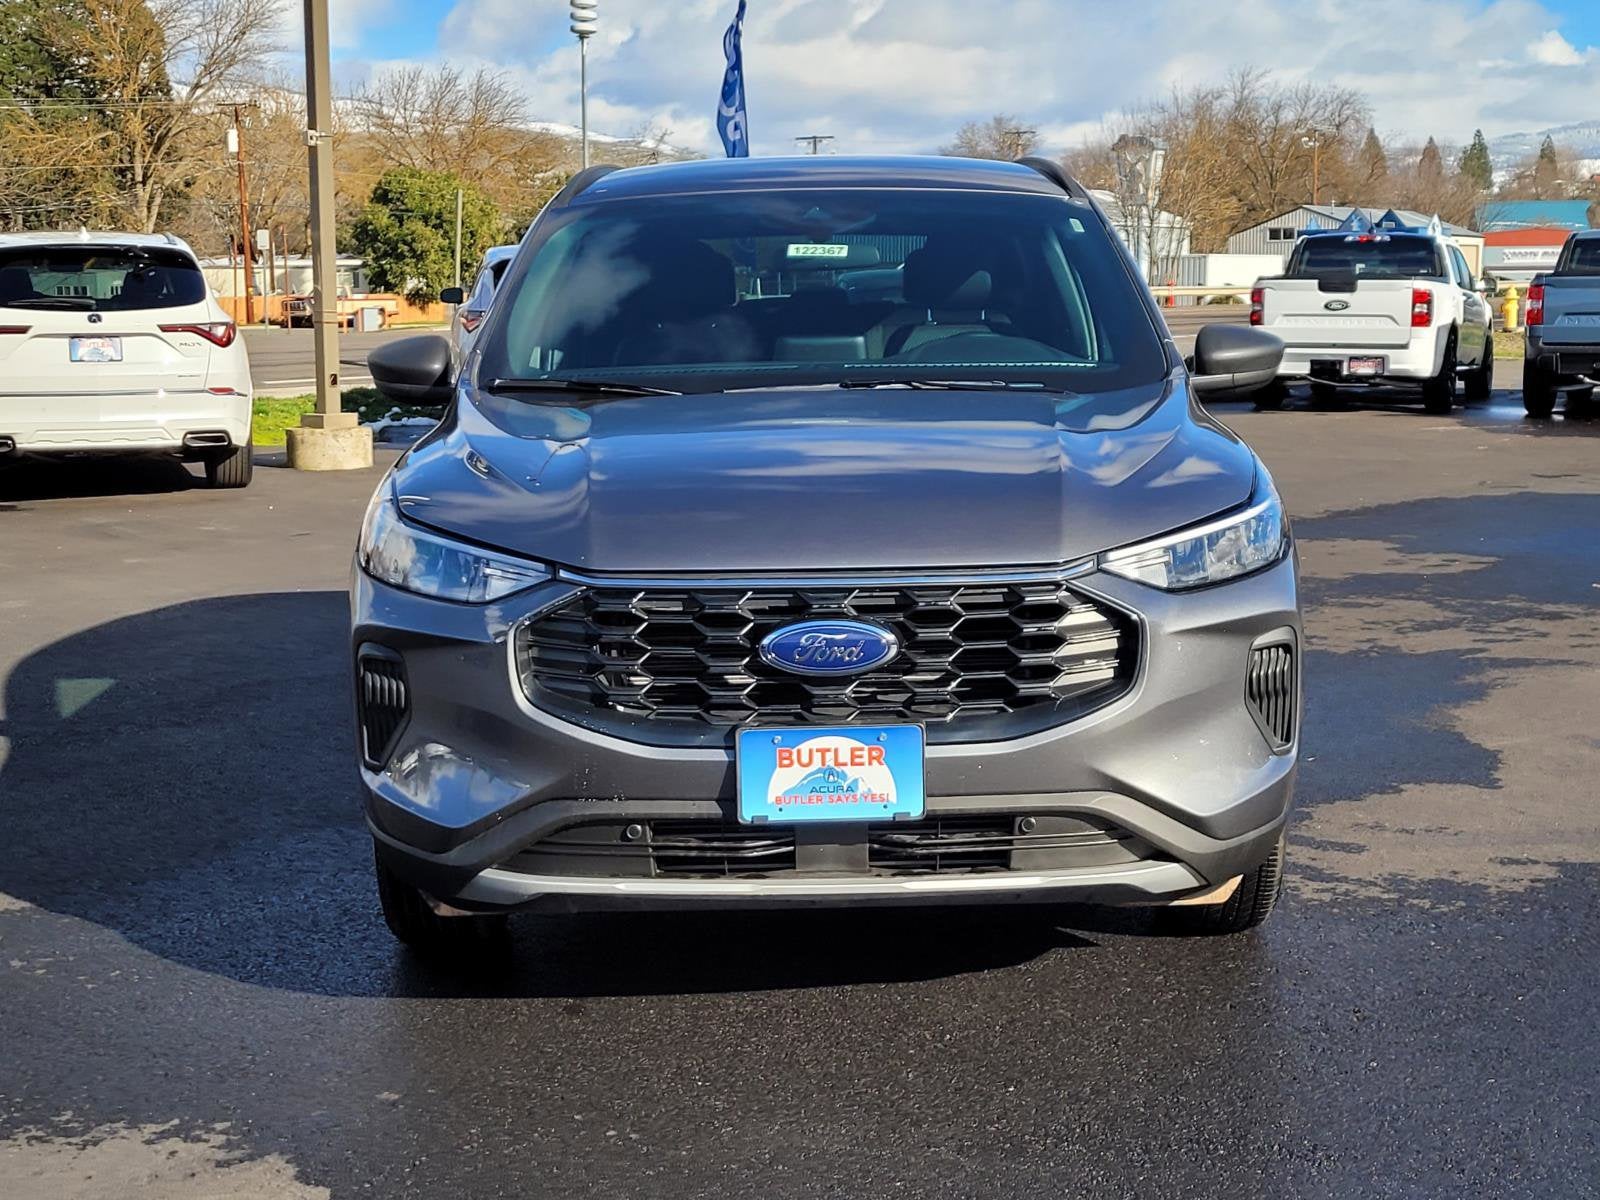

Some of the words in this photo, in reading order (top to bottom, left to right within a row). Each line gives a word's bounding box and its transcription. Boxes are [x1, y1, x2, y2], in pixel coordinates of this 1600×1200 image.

[793, 246, 845, 255] 122367
[793, 632, 866, 662] Ford
[777, 746, 885, 768] BUTLER
[809, 785, 855, 794] ACURA
[775, 795, 823, 805] BUTLER
[826, 793, 858, 803] SAYS
[861, 792, 890, 803] YES!
